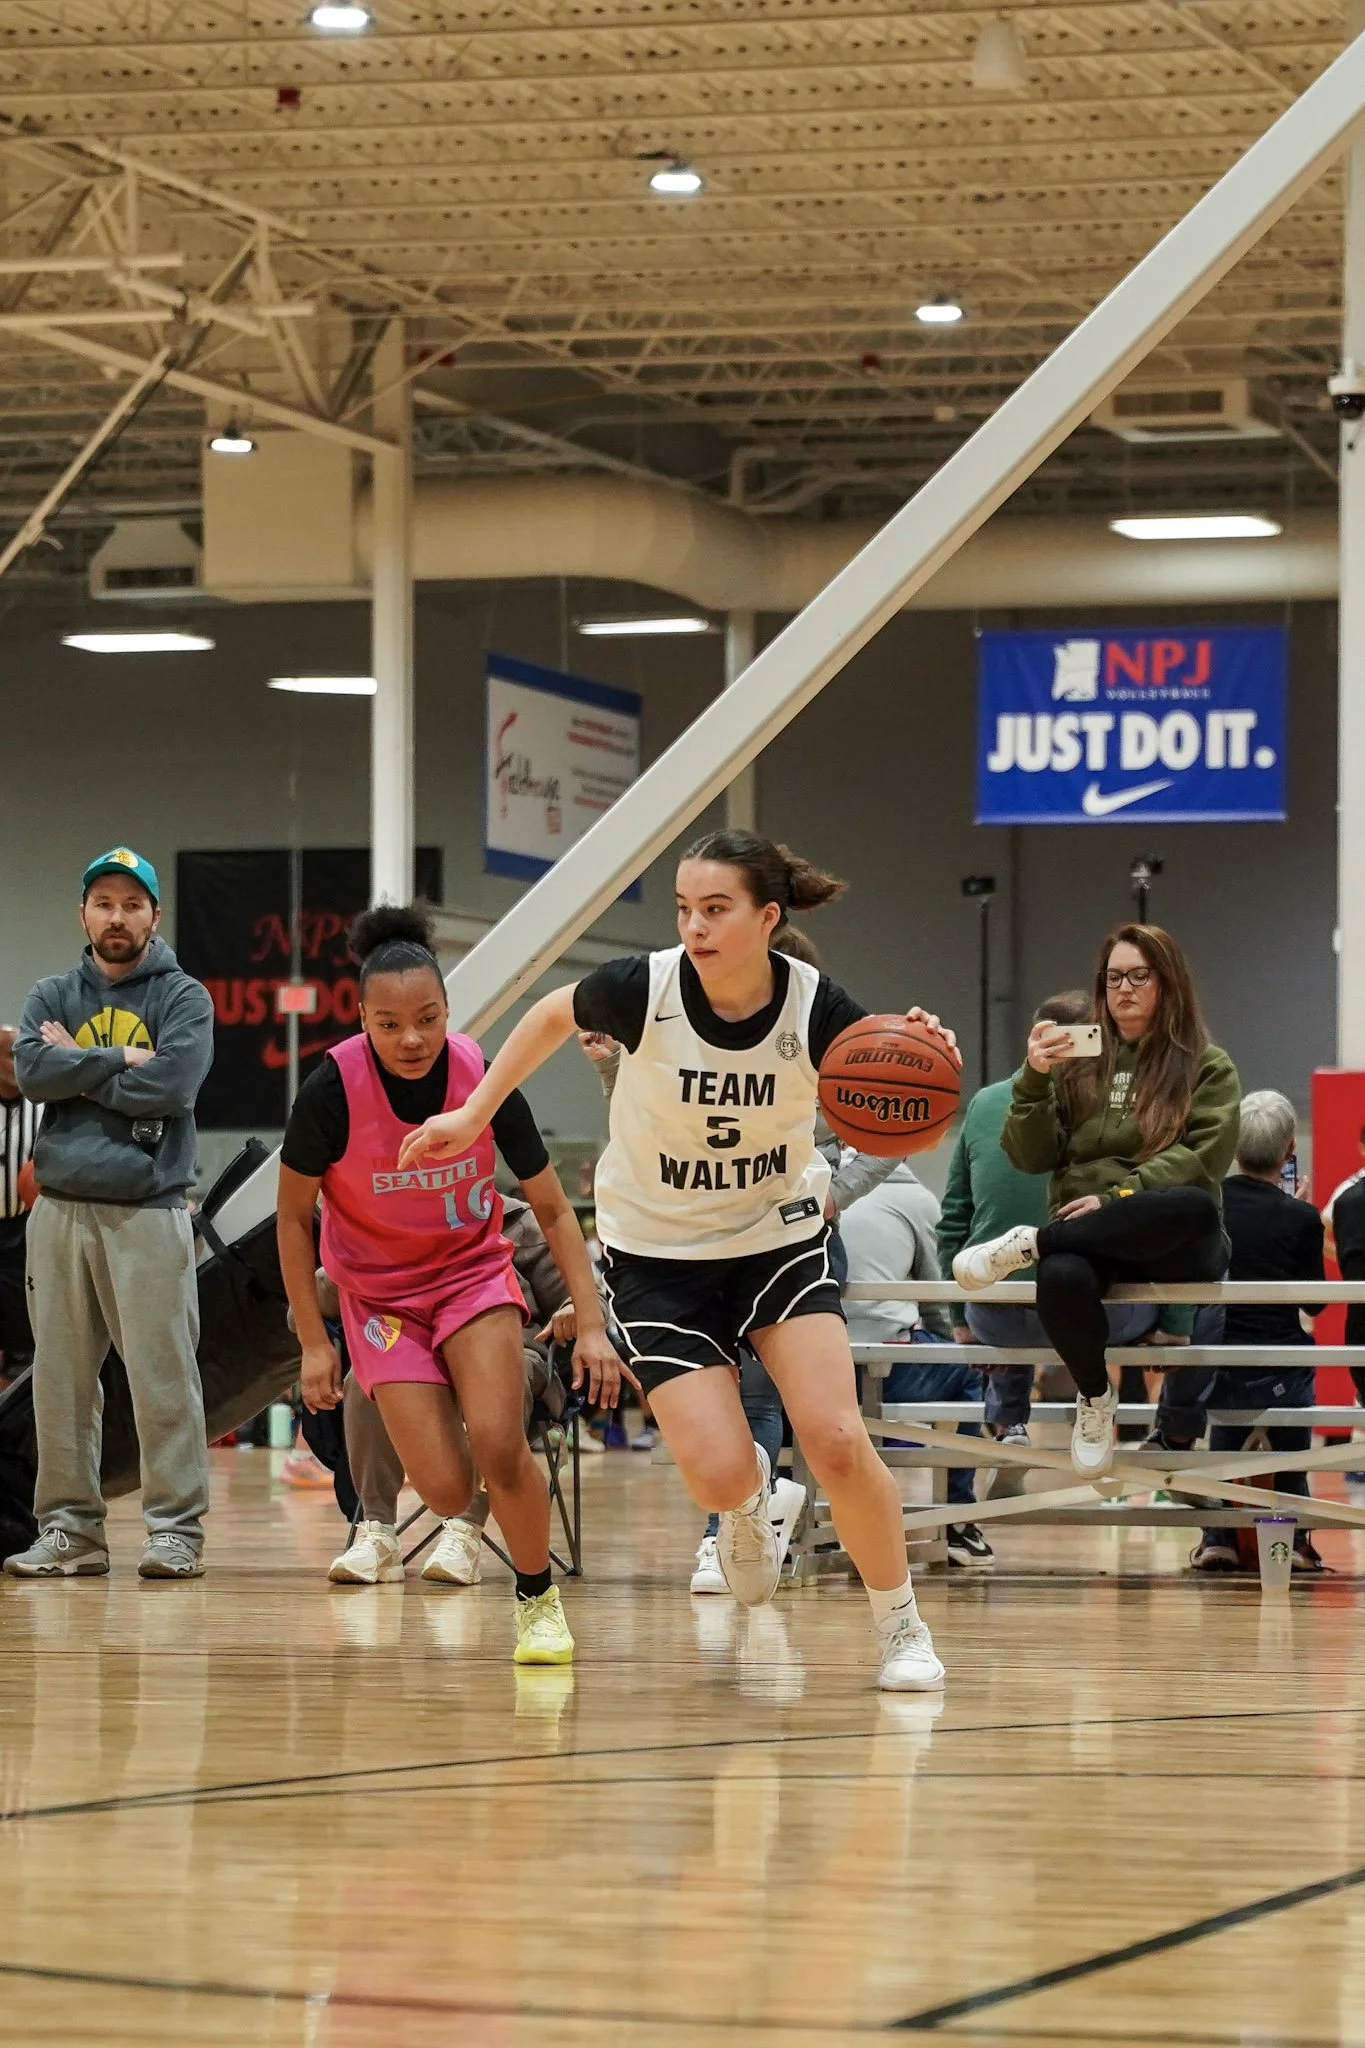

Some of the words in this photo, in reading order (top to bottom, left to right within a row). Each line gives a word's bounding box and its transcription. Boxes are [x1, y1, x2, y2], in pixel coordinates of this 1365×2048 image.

[1105, 639, 1211, 687] NPJ
[988, 711, 1115, 772] JUST
[1120, 709, 1200, 770] DO
[1205, 709, 1276, 769] IT.
[203, 977, 296, 1025] UST
[845, 1050, 934, 1073] EVOLUTION
[679, 1068, 776, 1106] TEAM
[836, 1087, 930, 1122] Wilson
[706, 1116, 741, 1149] 5
[375, 1161, 476, 1190] SEATTLE
[659, 1144, 787, 1190] WALTON
